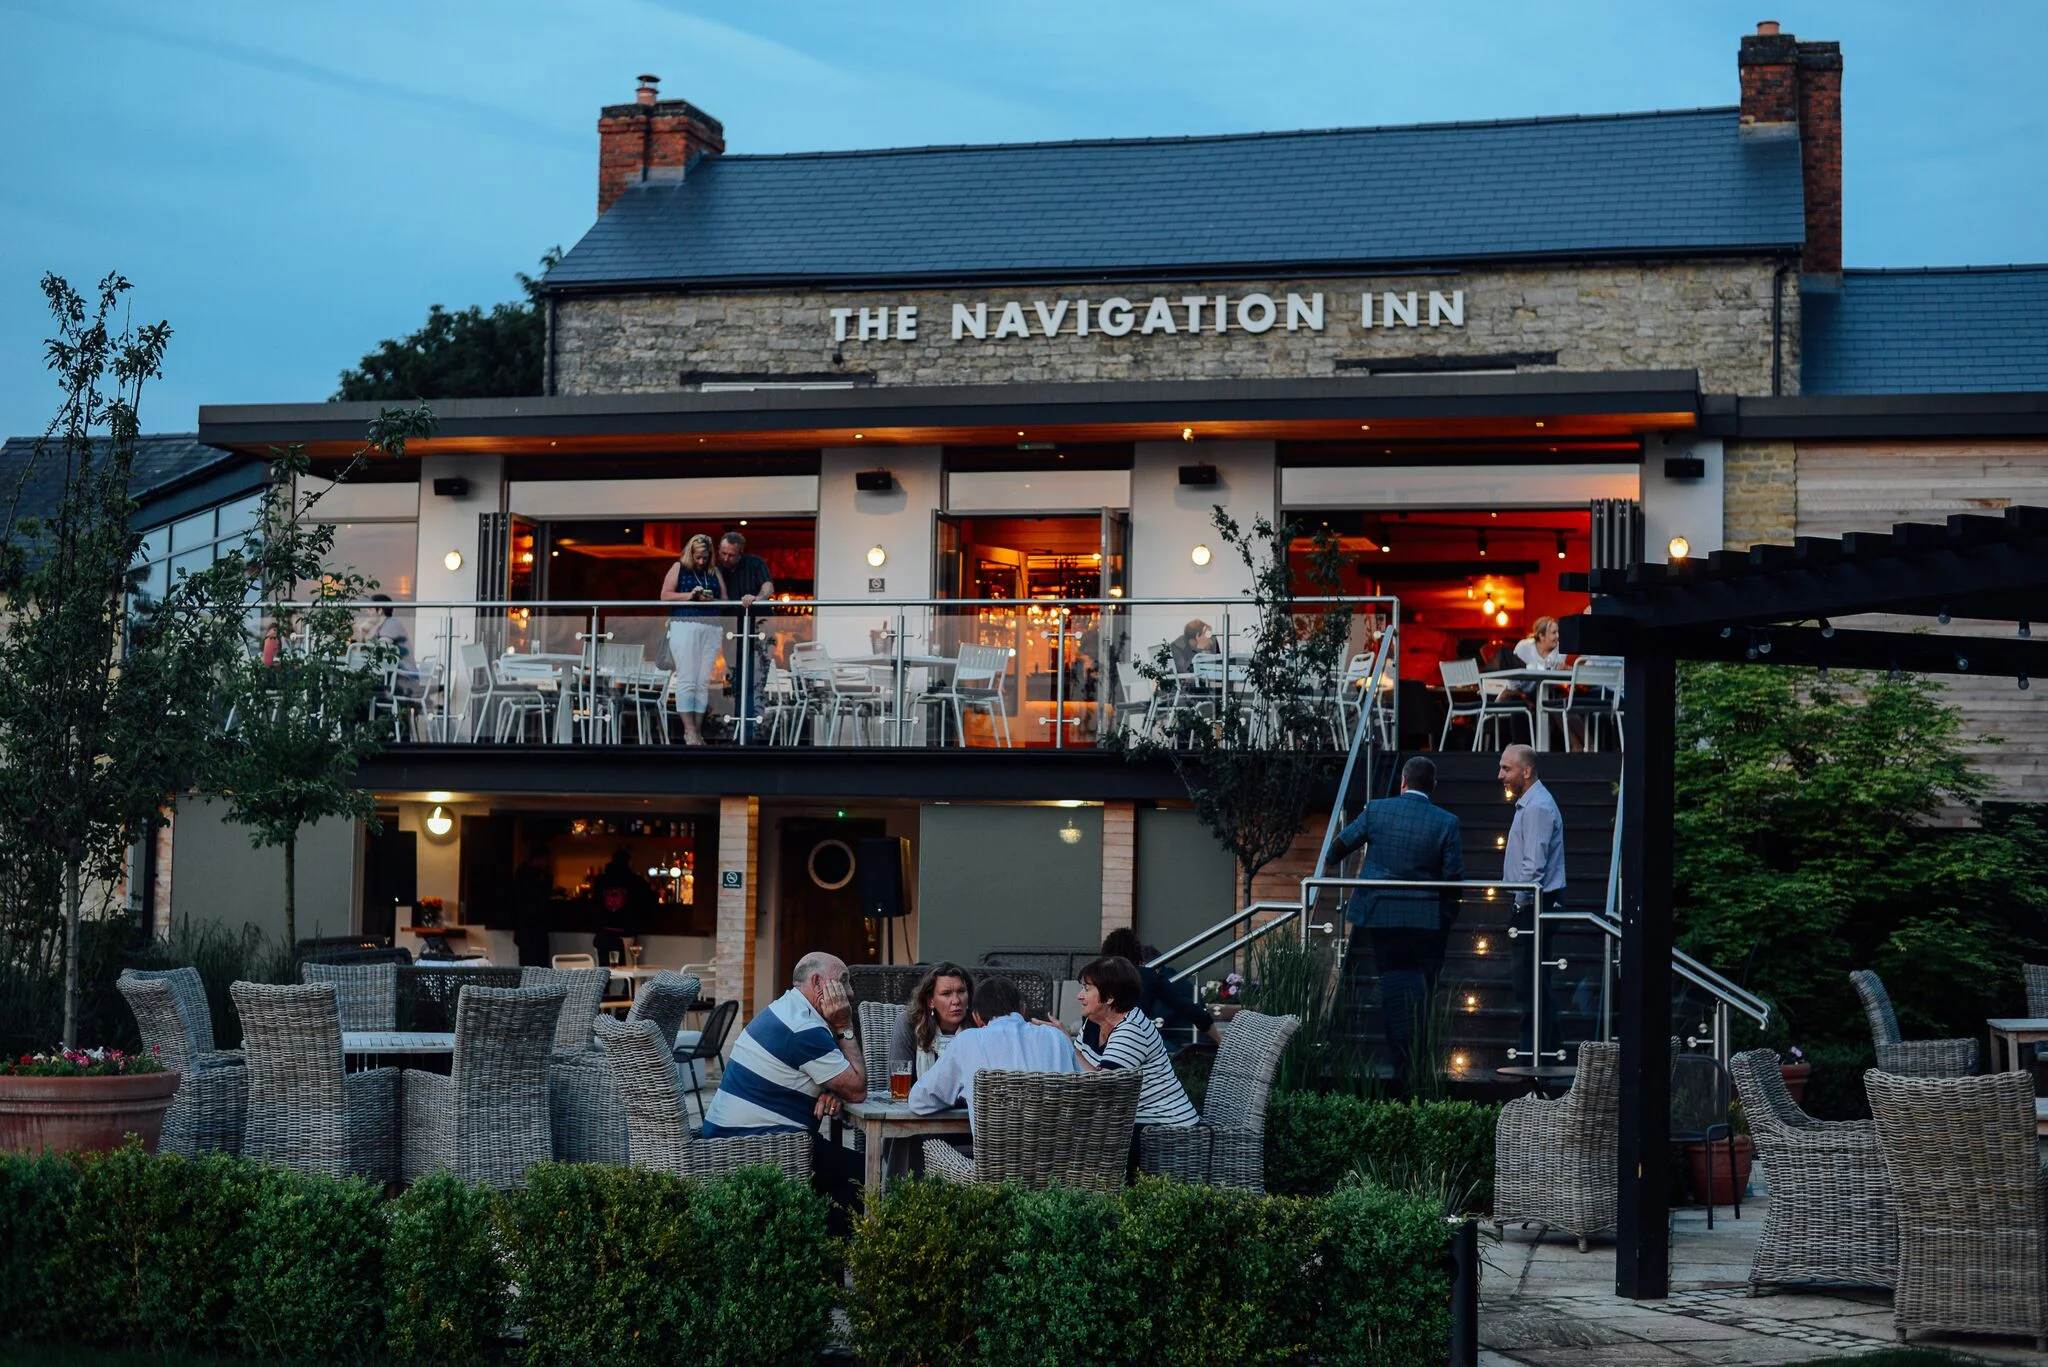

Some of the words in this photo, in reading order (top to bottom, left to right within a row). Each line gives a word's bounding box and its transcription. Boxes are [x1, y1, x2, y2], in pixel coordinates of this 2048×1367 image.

[830, 306, 917, 342] THE
[952, 293, 1324, 340] NAVIGATION
[1362, 290, 1464, 329] INN
